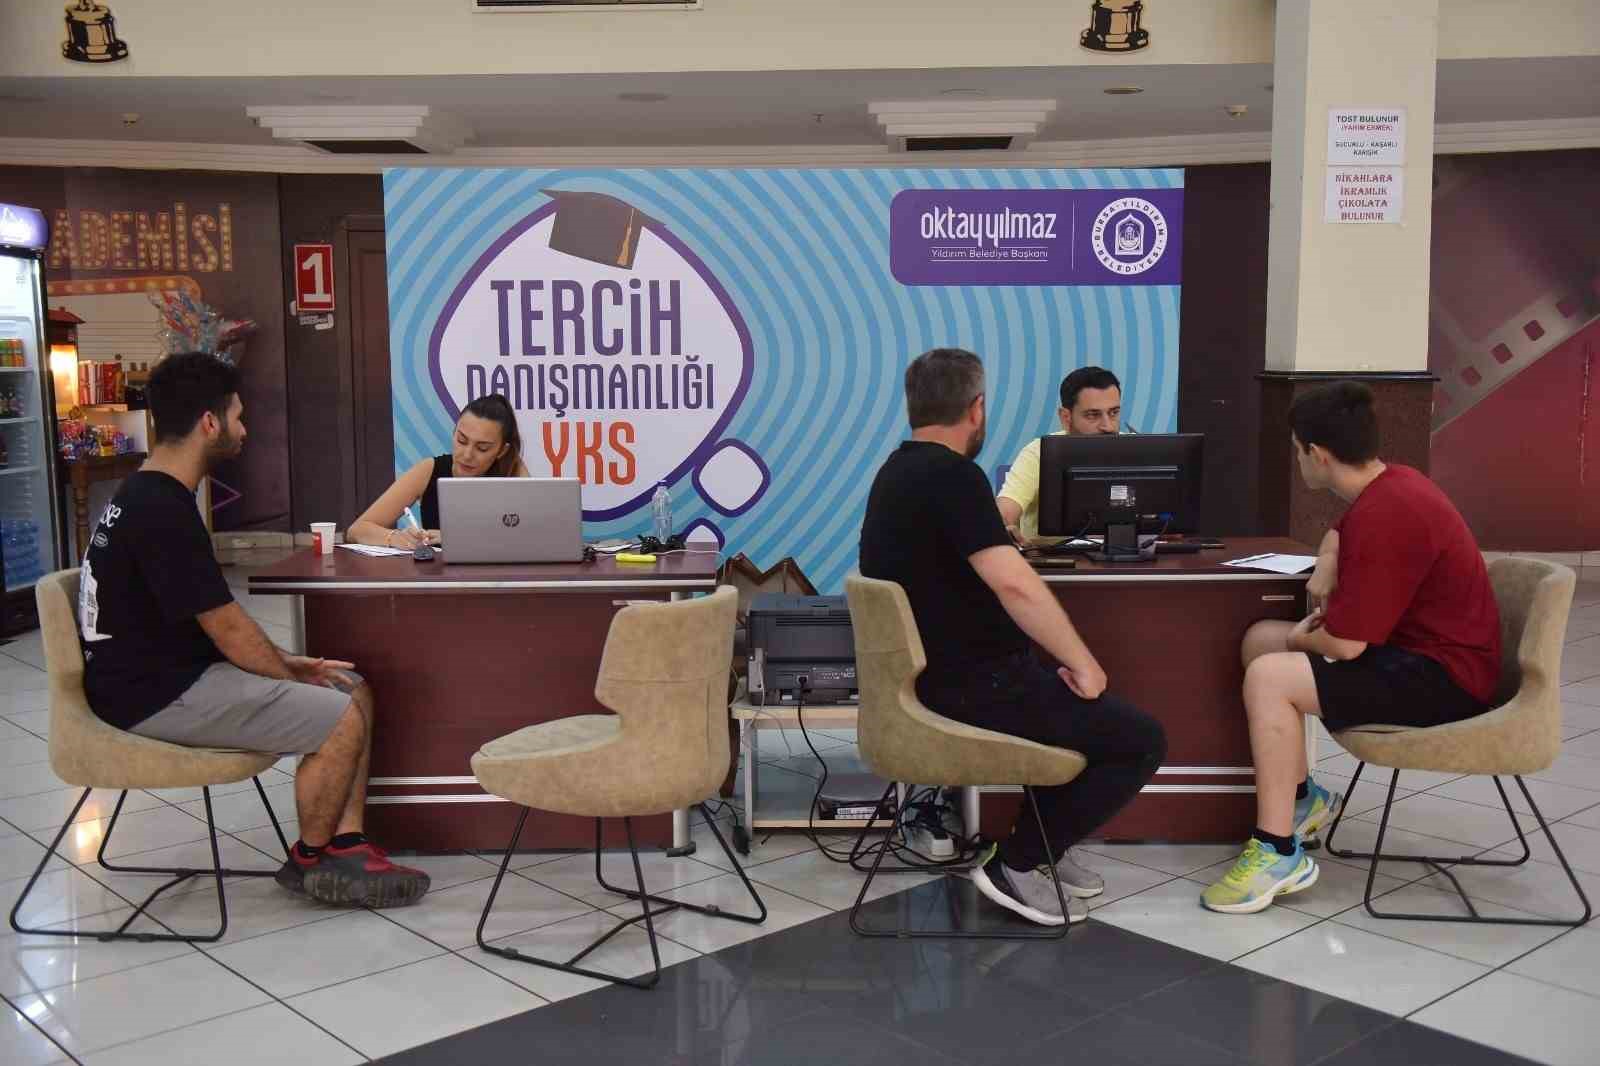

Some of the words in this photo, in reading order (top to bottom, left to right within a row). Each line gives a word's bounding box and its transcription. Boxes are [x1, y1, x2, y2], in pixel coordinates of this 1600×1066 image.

[1337, 115, 1357, 123] TOST
[1360, 115, 1399, 123] BULUNUR
[1338, 198, 1388, 208] ÇİKOLATA
[1341, 212, 1384, 220] BULUNUR
[969, 249, 1009, 259] Belediye
[302, 252, 332, 303] 1
[466, 355, 714, 417] DANIŞMANLIĞI
[542, 421, 636, 485] YKS
[503, 513, 520, 527] hp
